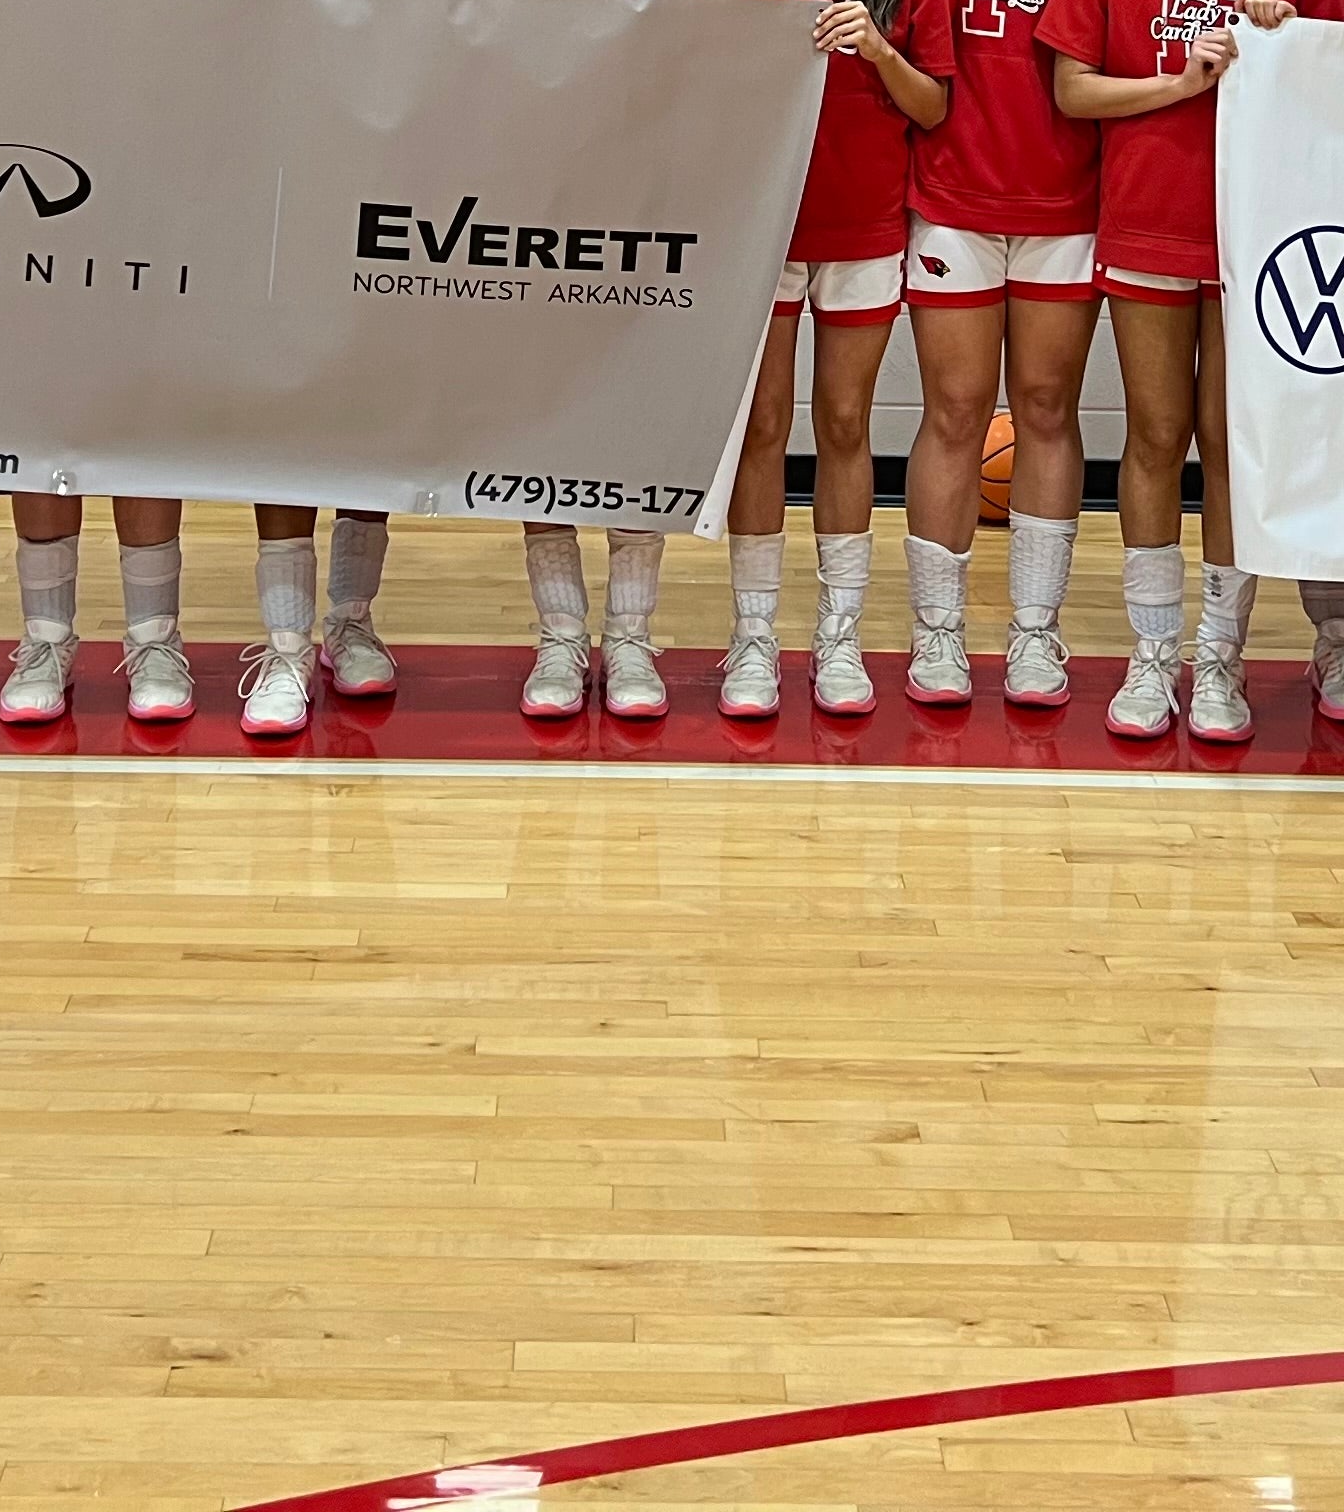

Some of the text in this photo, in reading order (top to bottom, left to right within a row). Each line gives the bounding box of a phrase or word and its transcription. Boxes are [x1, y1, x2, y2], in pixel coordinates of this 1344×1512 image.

[356, 196, 699, 275] EVERETT
[352, 272, 695, 309] NORTHWEST ARKANSAS
